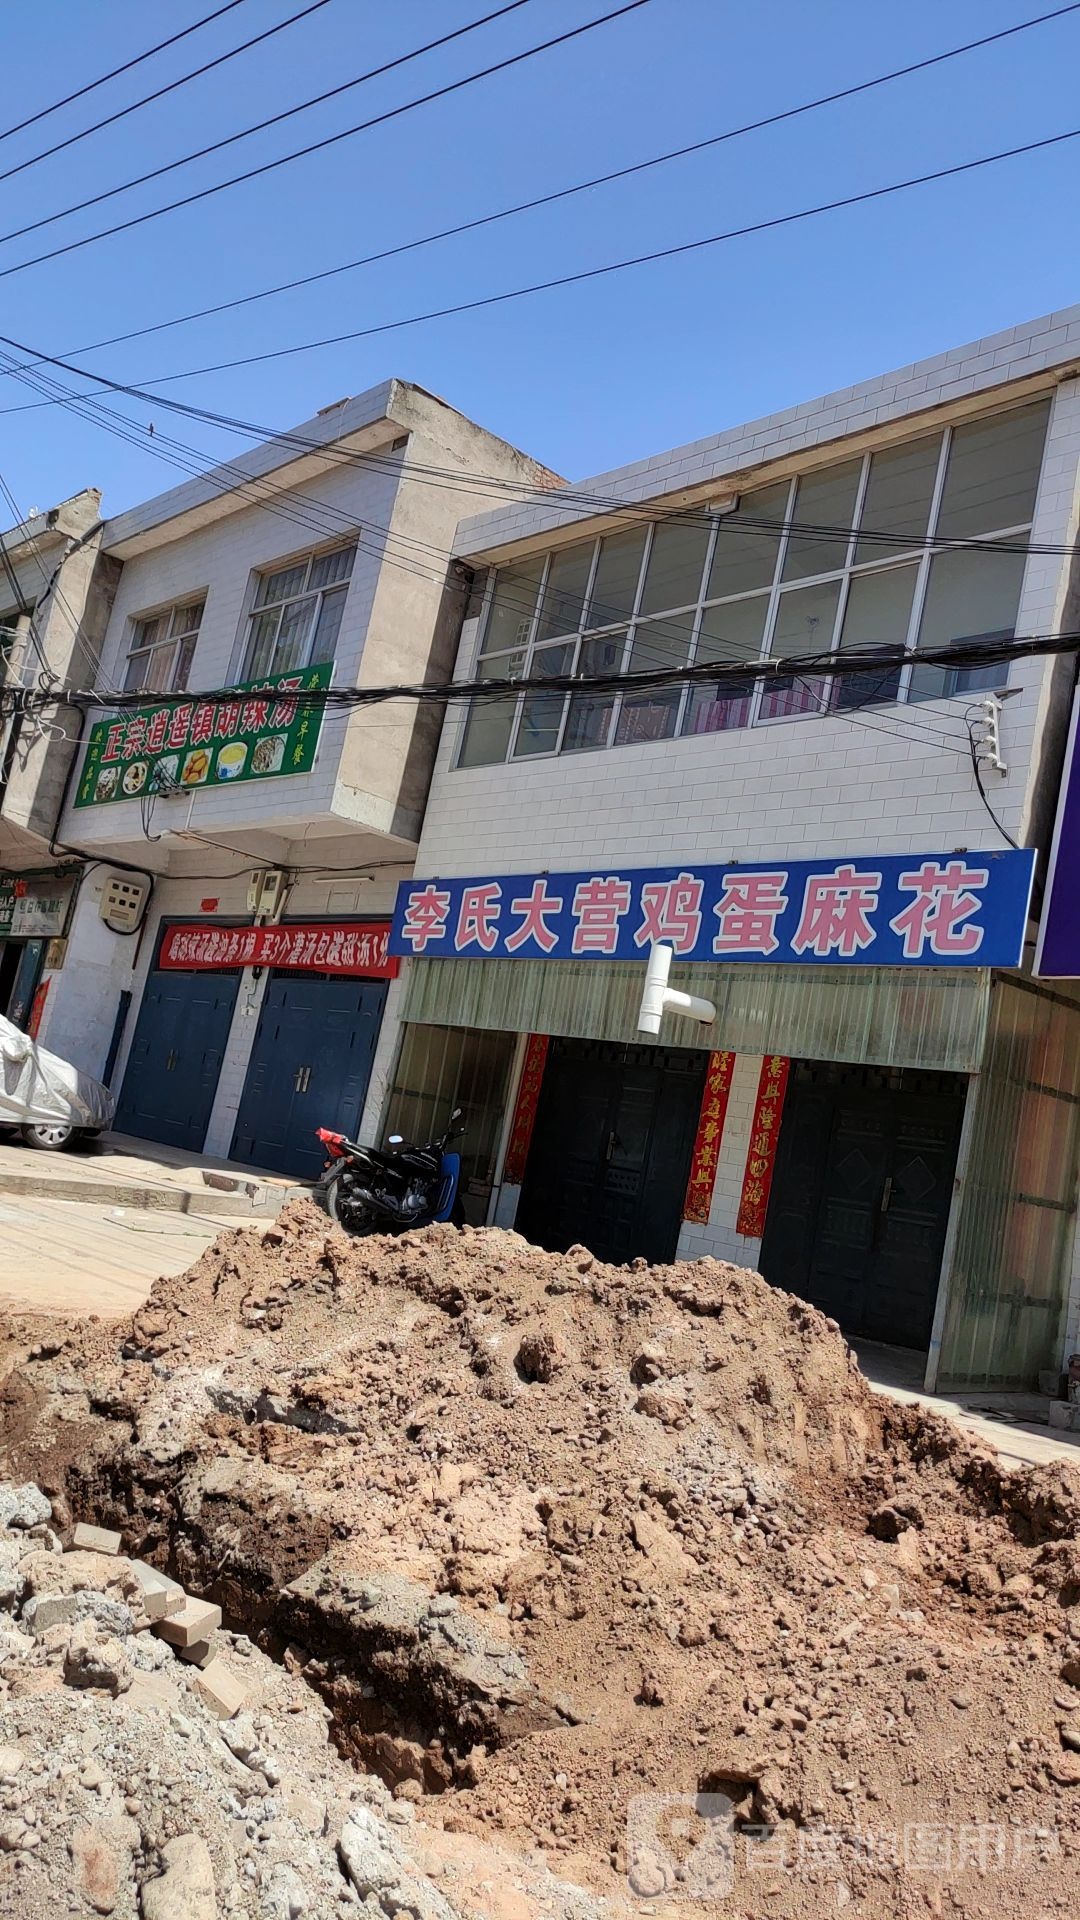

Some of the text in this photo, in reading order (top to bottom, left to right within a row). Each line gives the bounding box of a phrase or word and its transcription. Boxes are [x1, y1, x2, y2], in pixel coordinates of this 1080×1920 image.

[101, 677, 303, 763] 正宗逍遥镇胡辣汤
[402, 862, 988, 958] 李氏大营鸡蛋麻花
